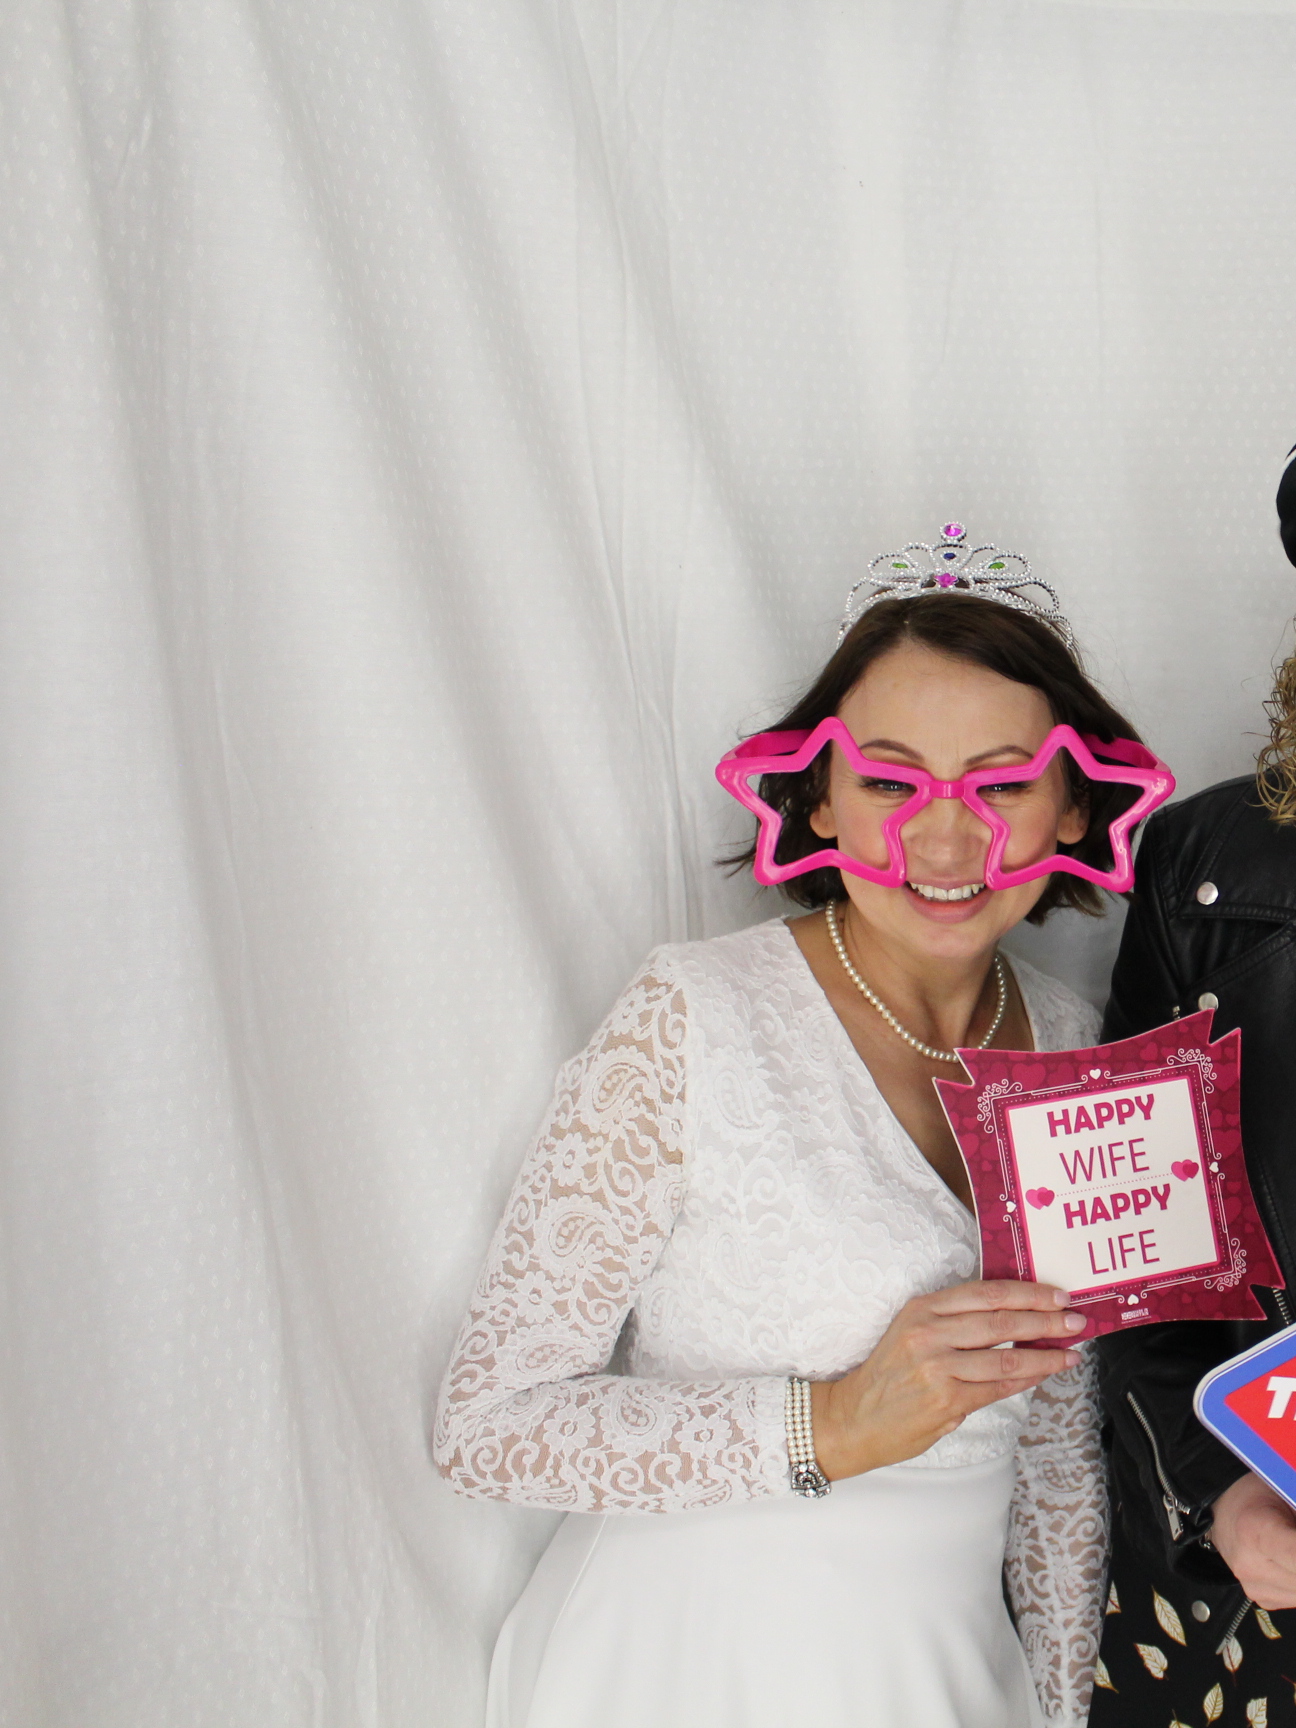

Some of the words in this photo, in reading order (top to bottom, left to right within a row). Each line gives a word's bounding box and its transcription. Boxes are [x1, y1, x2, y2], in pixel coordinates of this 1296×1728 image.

[1046, 1093, 1155, 1138] HAPPY
[1059, 1137, 1150, 1185] WIFE
[1063, 1183, 1171, 1229] HAPPY
[1087, 1229, 1160, 1275] LIFE
